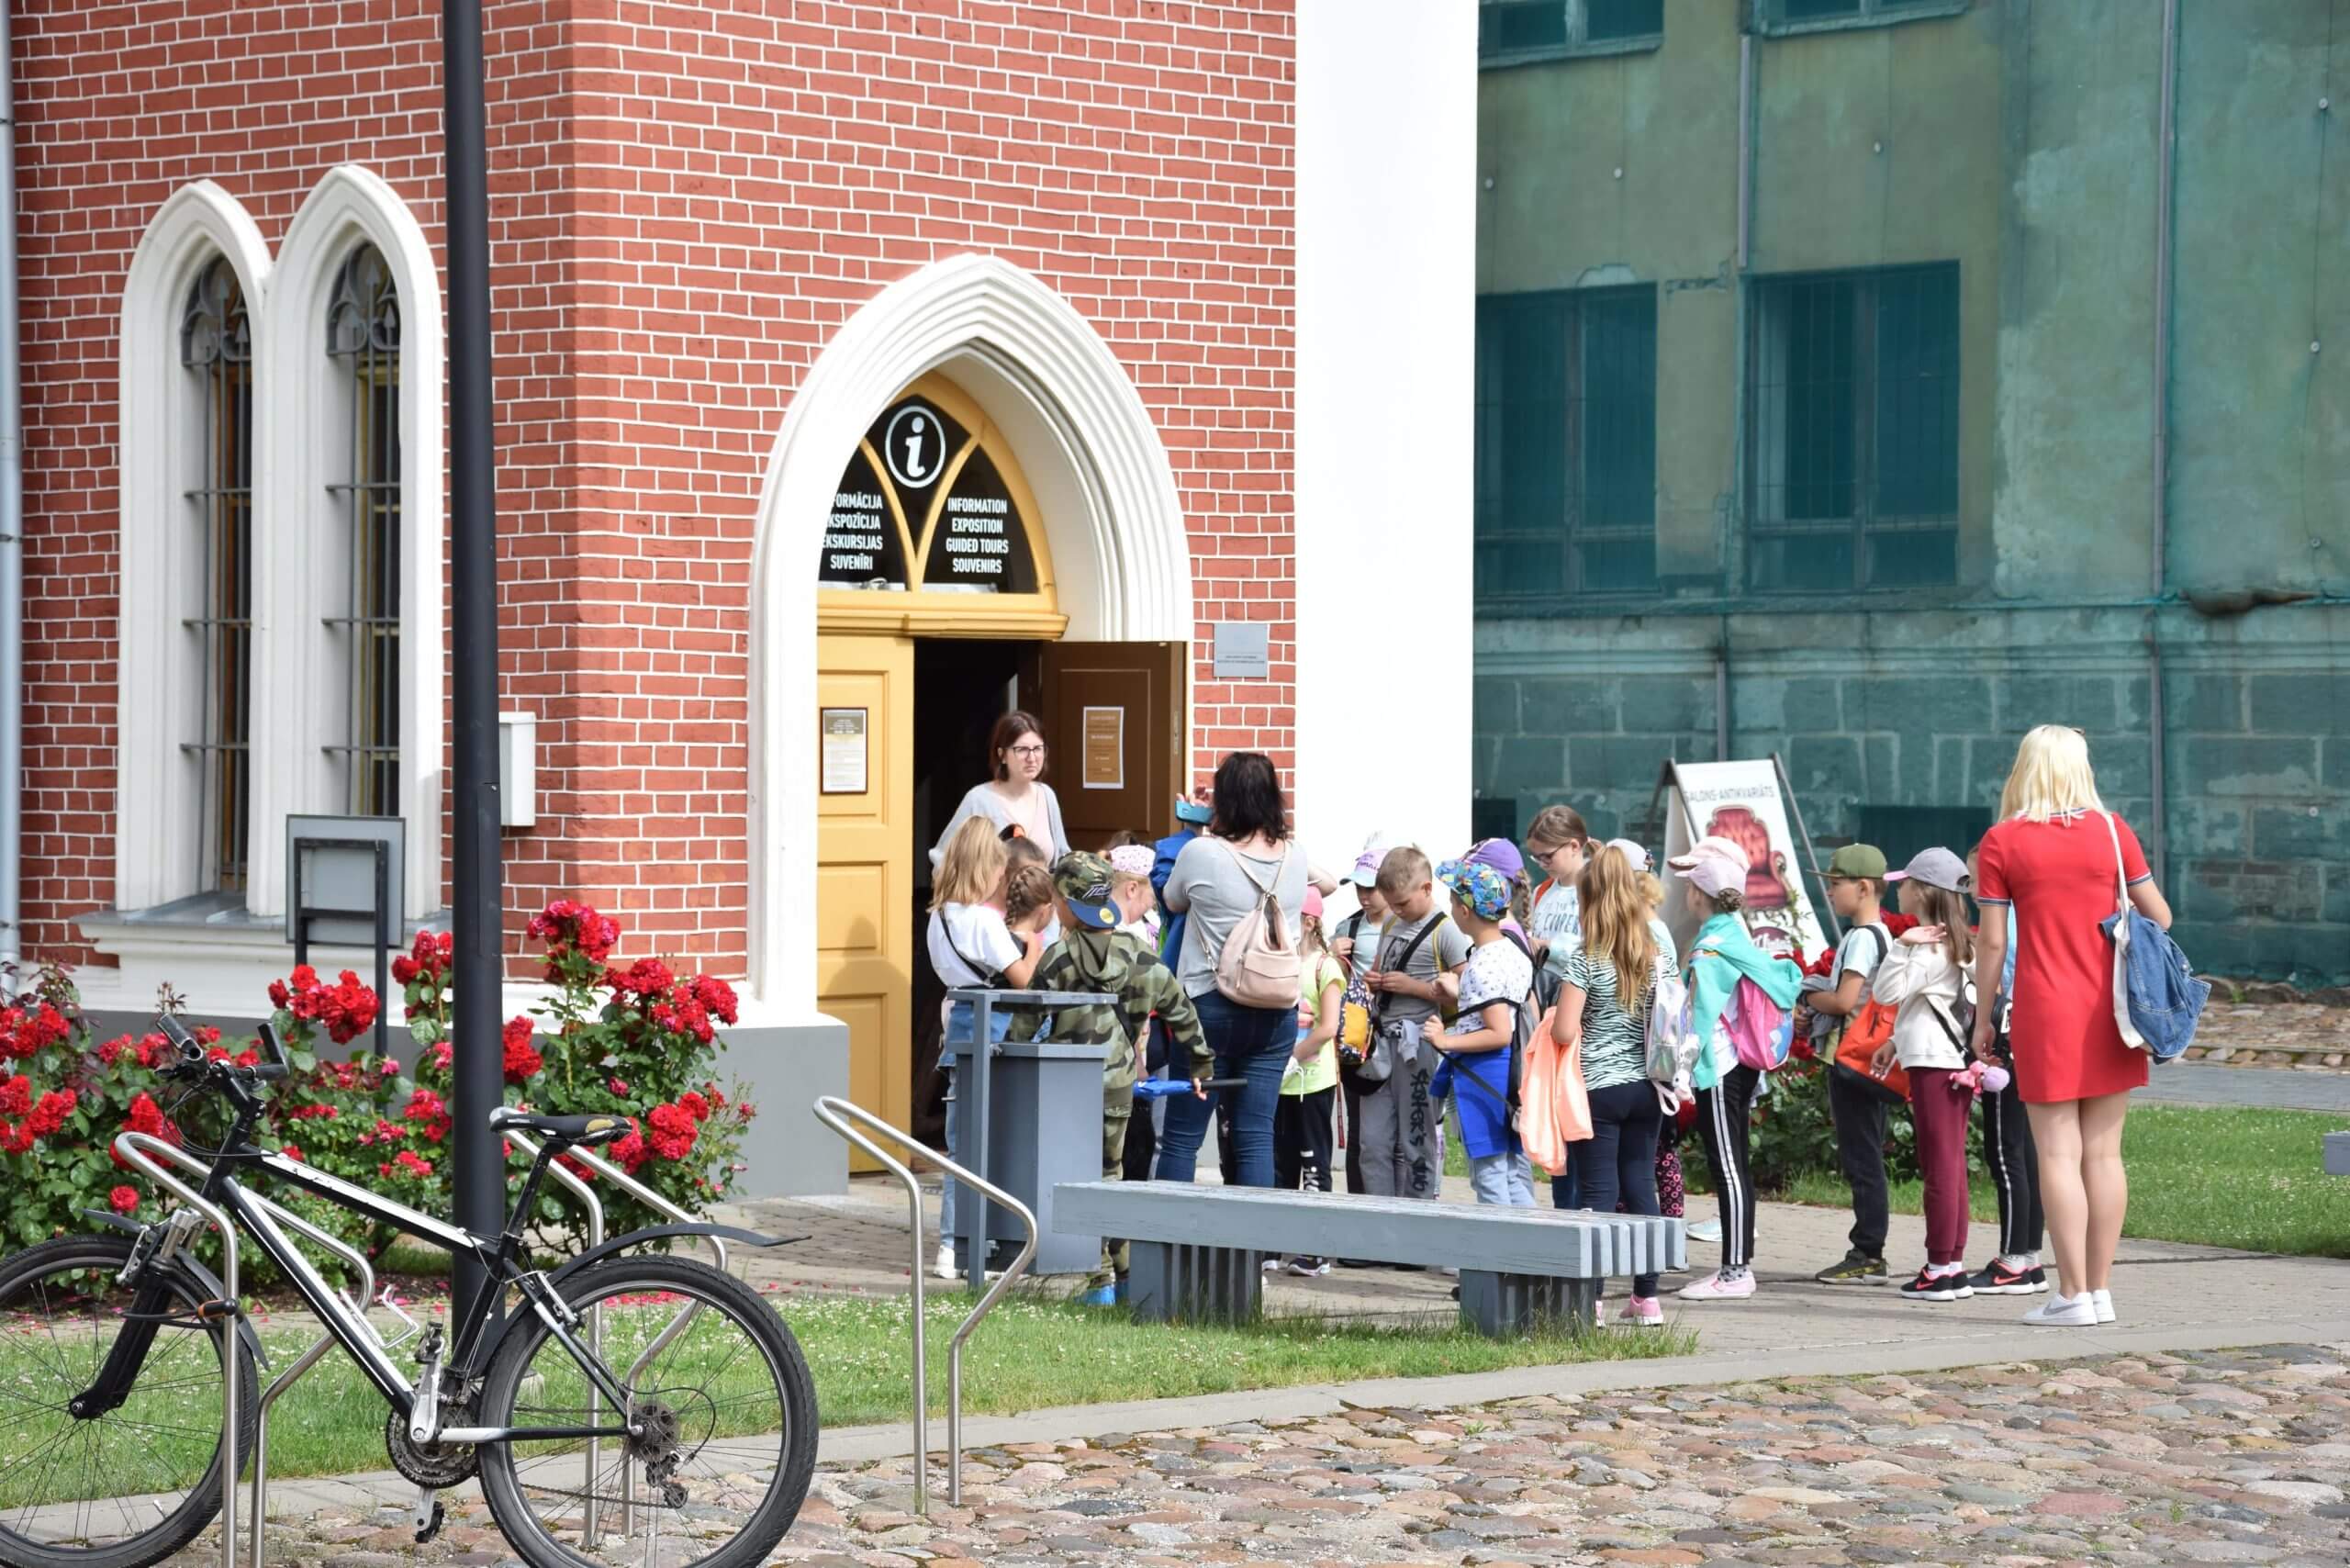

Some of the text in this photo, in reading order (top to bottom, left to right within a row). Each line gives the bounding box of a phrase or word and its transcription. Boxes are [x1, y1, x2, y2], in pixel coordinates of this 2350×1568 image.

[834, 491, 883, 510] ORMĀCIJA
[947, 498, 1007, 514] INFORMATION
[828, 512, 881, 530] KSPOZĪCIJA
[952, 518, 1003, 533] EXPOSITION
[946, 538, 1009, 554] GUIDED TOURS
[830, 553, 873, 570] SUVENĪRI
[952, 557, 1002, 573] SOUVENIRS
